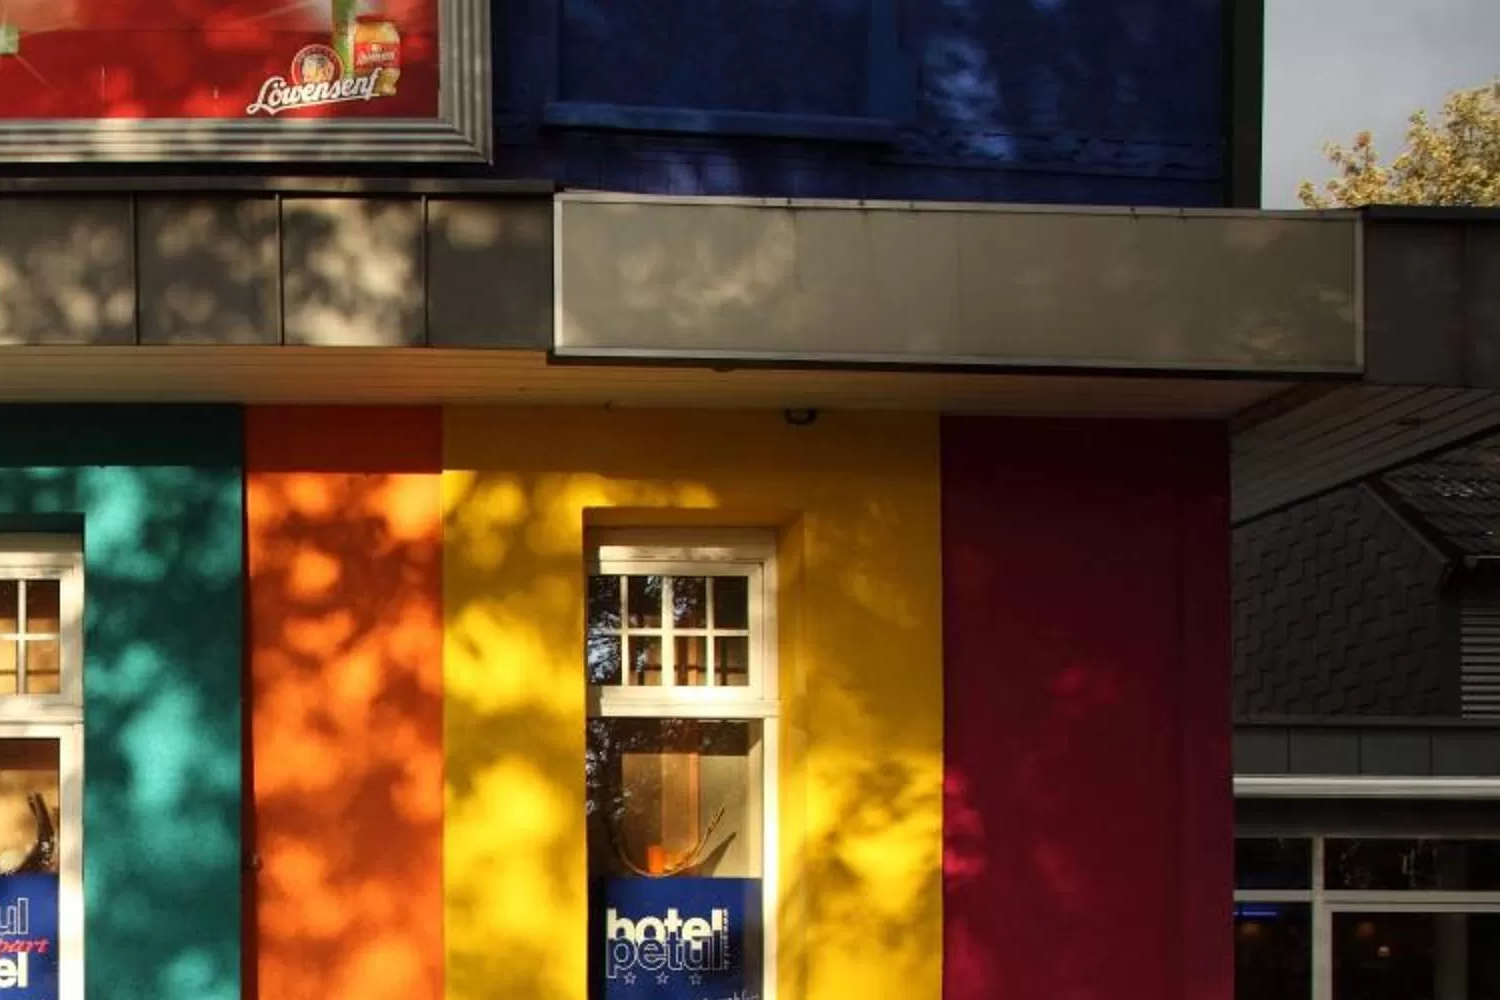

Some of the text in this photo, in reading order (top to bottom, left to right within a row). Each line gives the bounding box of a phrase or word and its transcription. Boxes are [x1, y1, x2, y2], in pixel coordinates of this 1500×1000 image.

[246, 67, 382, 115] Löwensenf
[606, 908, 723, 949] hotel
[605, 930, 724, 979] petul
